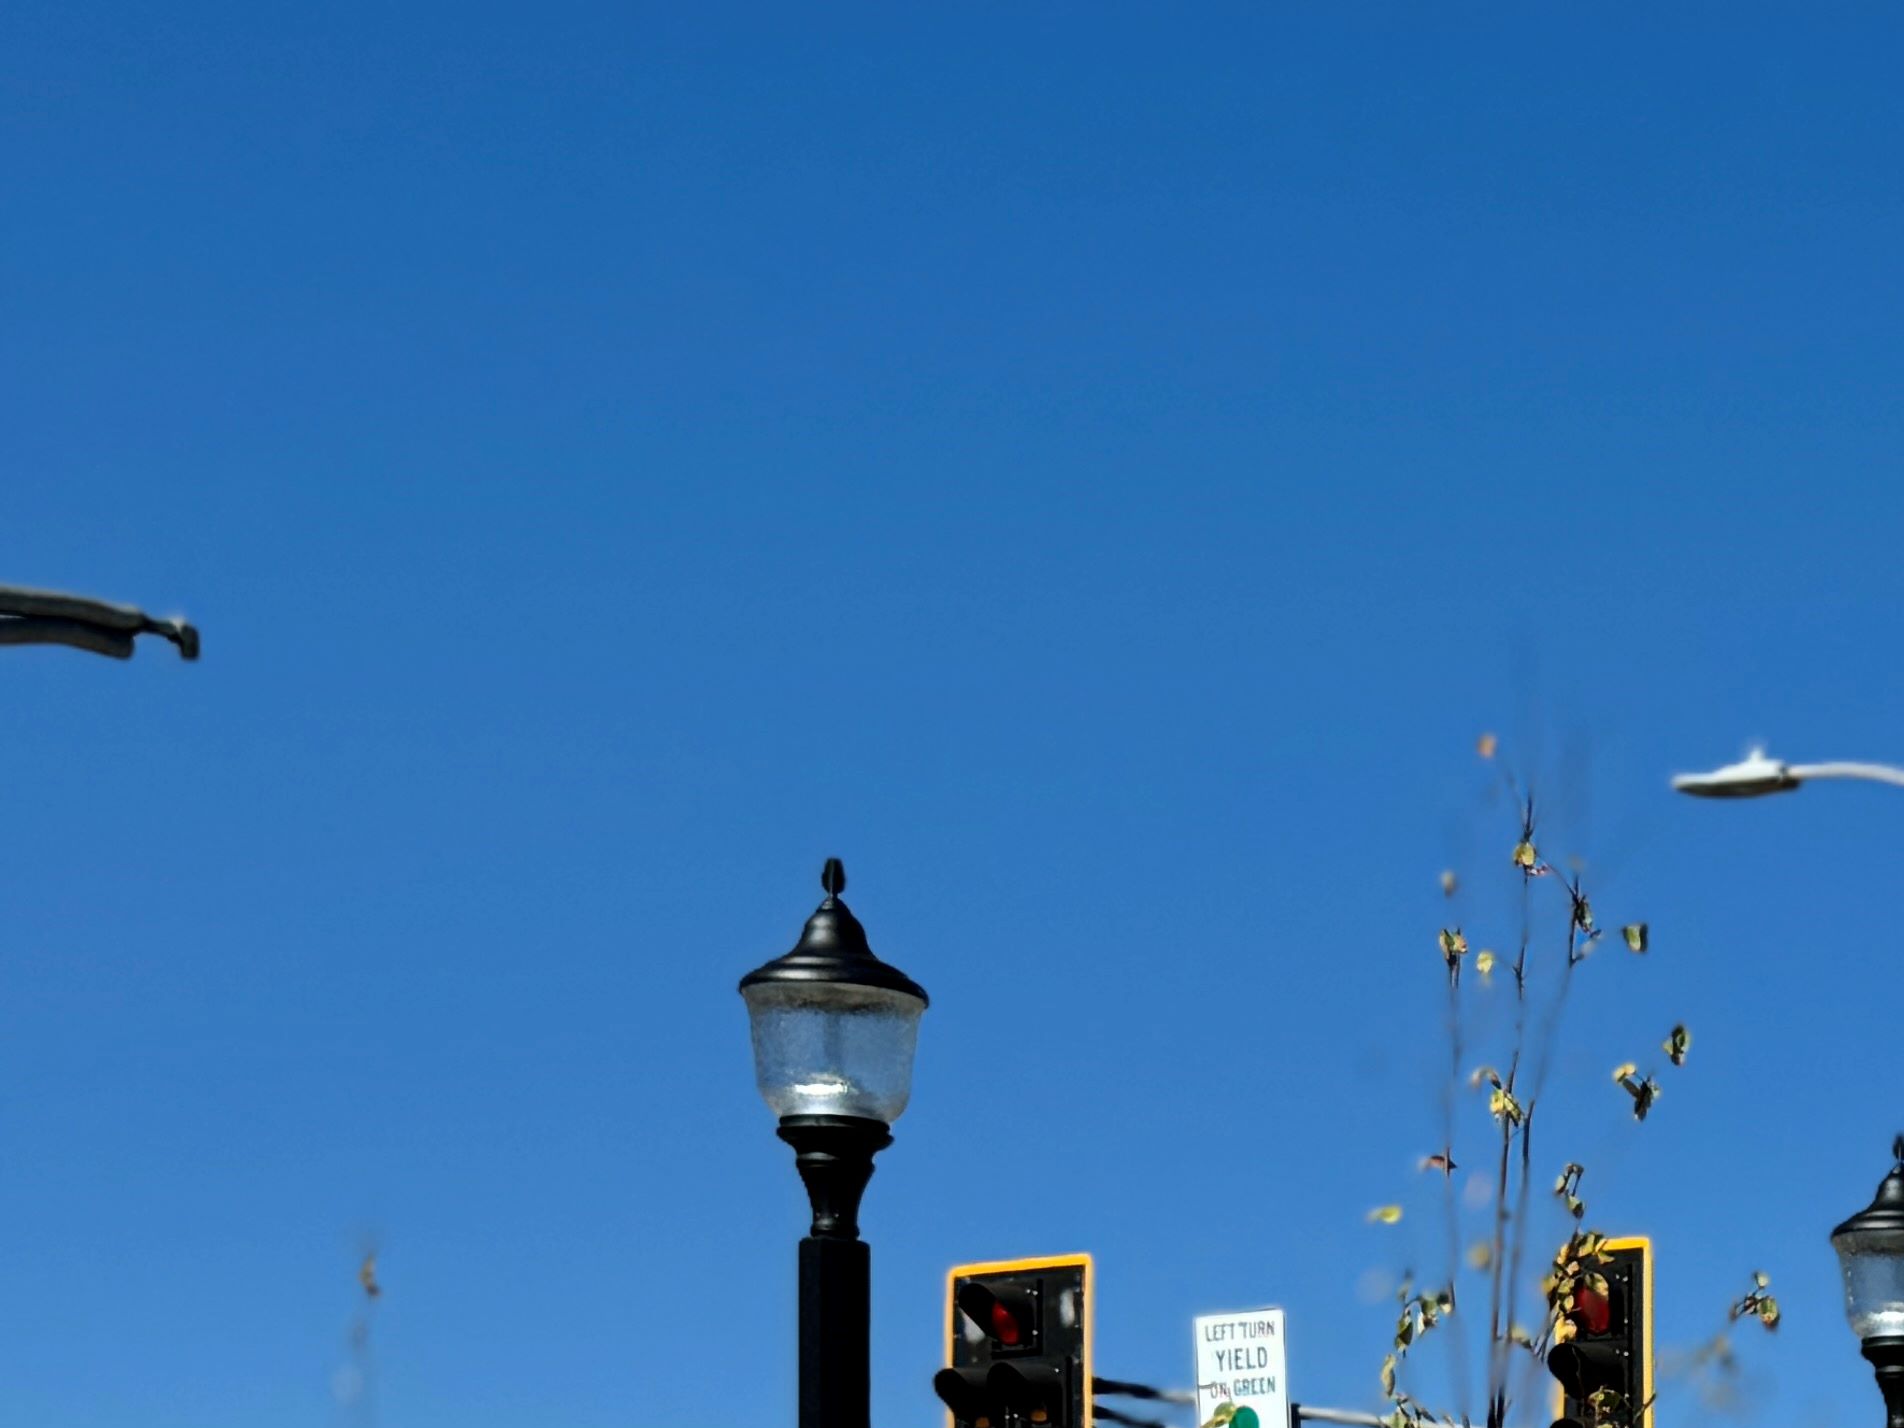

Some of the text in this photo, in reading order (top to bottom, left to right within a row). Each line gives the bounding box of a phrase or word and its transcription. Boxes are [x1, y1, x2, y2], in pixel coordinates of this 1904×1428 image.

[1205, 1320, 1275, 1342] LEFT TURN
[1216, 1346, 1268, 1372] YIELD
[1233, 1376, 1276, 1396] GREEN
